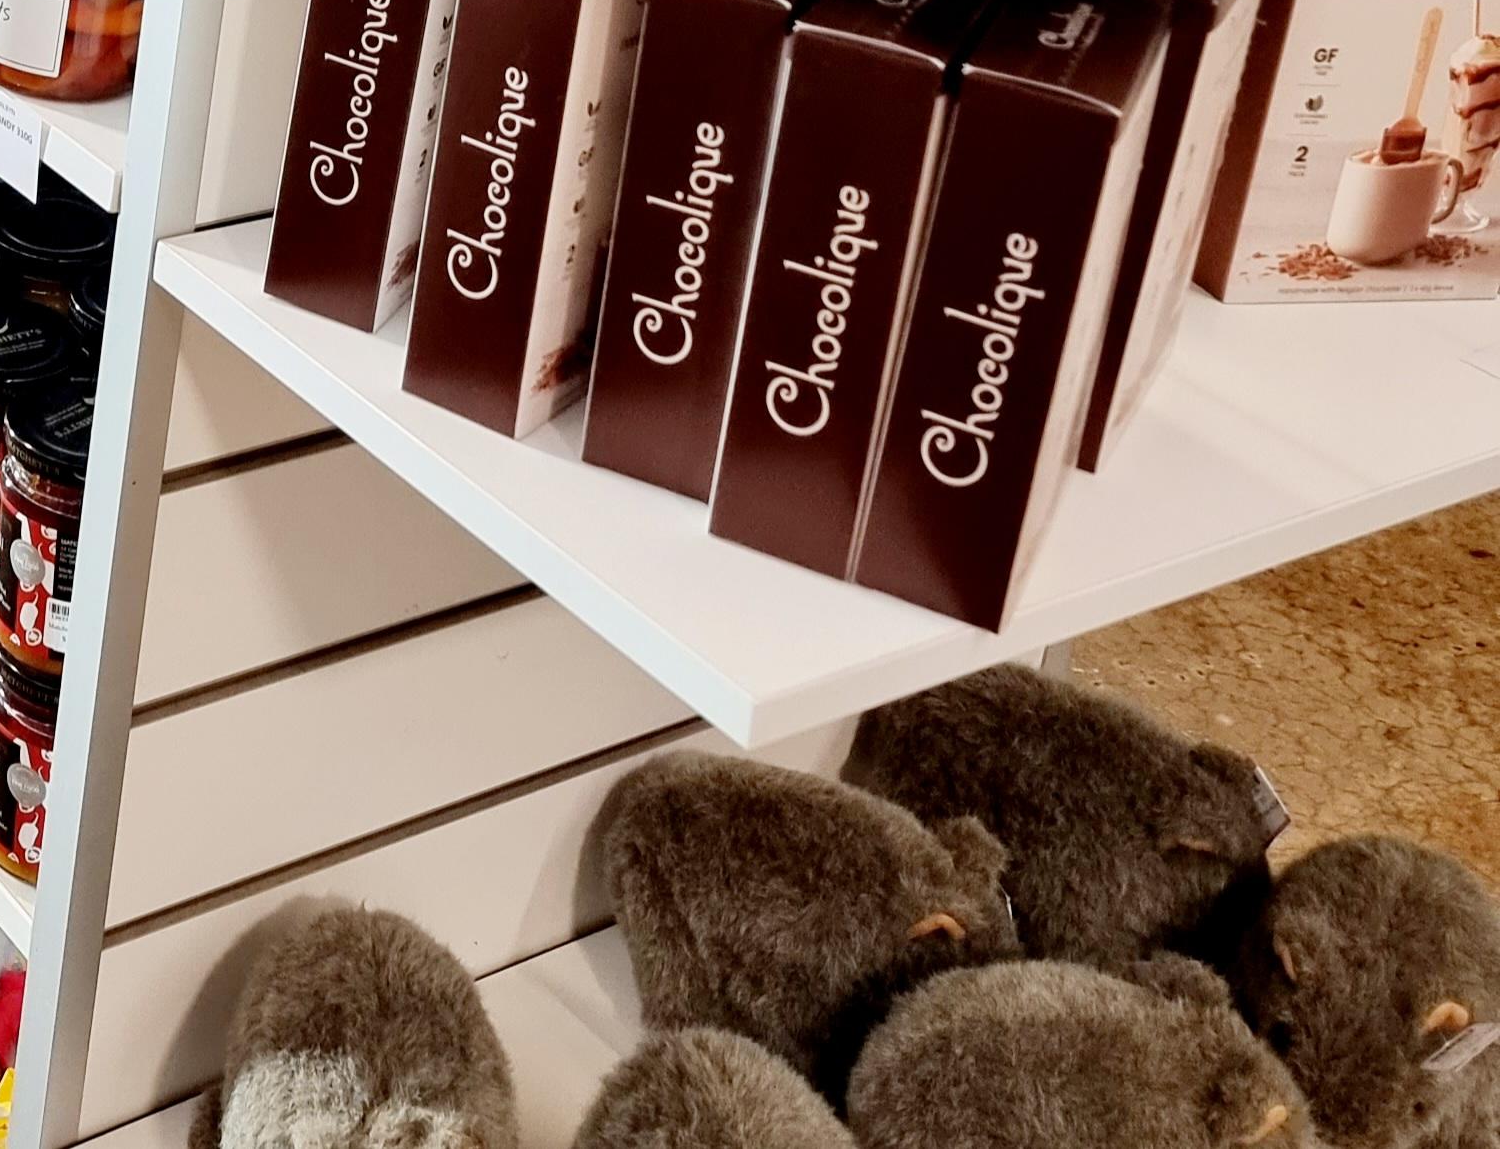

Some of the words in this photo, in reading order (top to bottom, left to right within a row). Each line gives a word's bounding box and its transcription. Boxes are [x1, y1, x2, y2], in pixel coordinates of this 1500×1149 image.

[1294, 145, 1309, 162] 2
[1314, 48, 1339, 63] GF
[447, 64, 536, 301] Chocolique
[633, 121, 733, 366] Chocolique
[766, 184, 878, 437] Chocolique
[920, 231, 1046, 487] Chocolique
